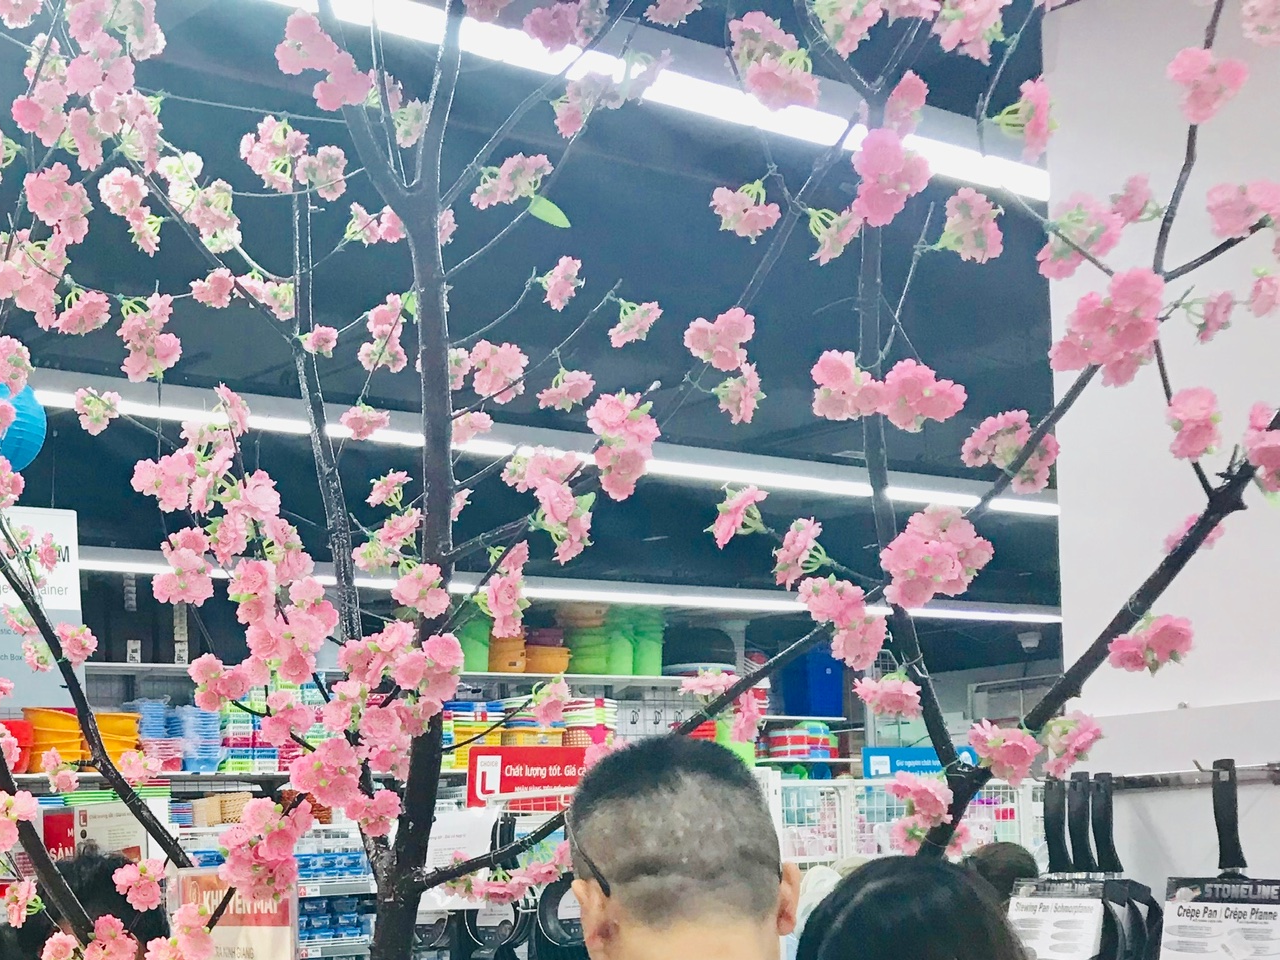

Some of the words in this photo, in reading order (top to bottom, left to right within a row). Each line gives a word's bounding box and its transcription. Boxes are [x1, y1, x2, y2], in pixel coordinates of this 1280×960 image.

[10, 653, 23, 662] Box
[505, 764, 523, 777] Chất
[524, 764, 547, 779] lượng
[564, 763, 576, 777] Giá
[1204, 883, 1280, 900] STONELINE
[1014, 901, 1037, 914] Stewing
[1038, 903, 1049, 913] Pan
[1176, 904, 1200, 920] Crêpe
[1202, 906, 1217, 919] Pan
[1250, 907, 1278, 920] Pfanne
